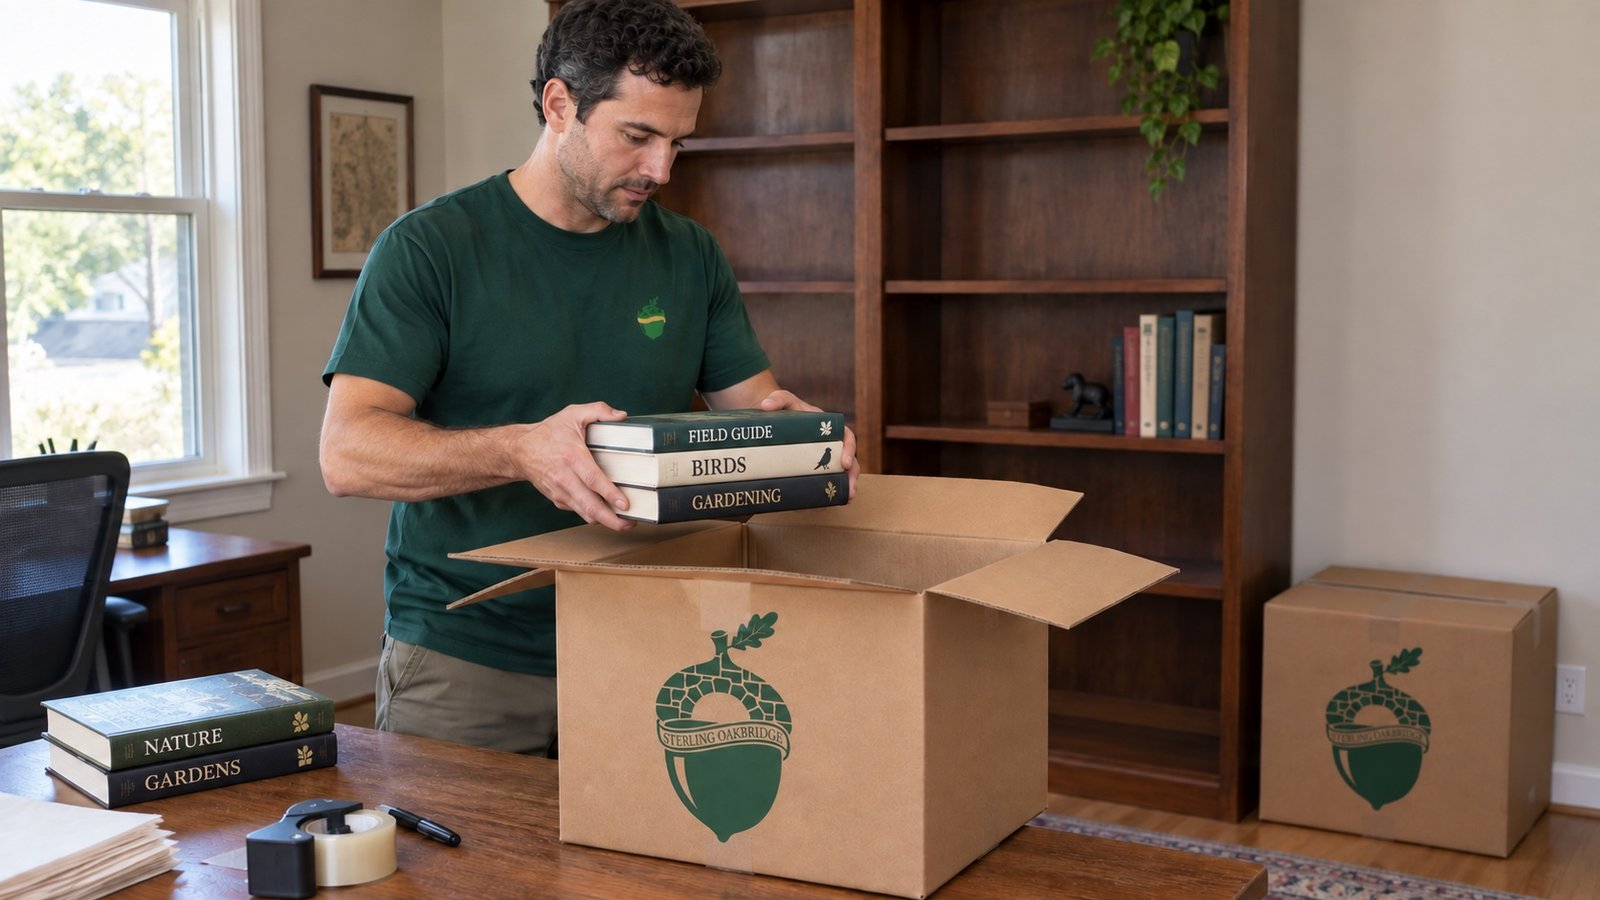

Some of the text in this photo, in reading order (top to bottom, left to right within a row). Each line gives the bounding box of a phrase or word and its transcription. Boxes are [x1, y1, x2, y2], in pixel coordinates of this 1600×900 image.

[688, 427, 728, 444] FIELD
[730, 425, 773, 441] GUIDE
[692, 457, 747, 477] BIRDS
[692, 489, 781, 510] GARDENING
[144, 727, 223, 756] NATURE
[663, 726, 783, 747] STERLING OAKBRIDGE
[144, 759, 241, 791] GARDENS
